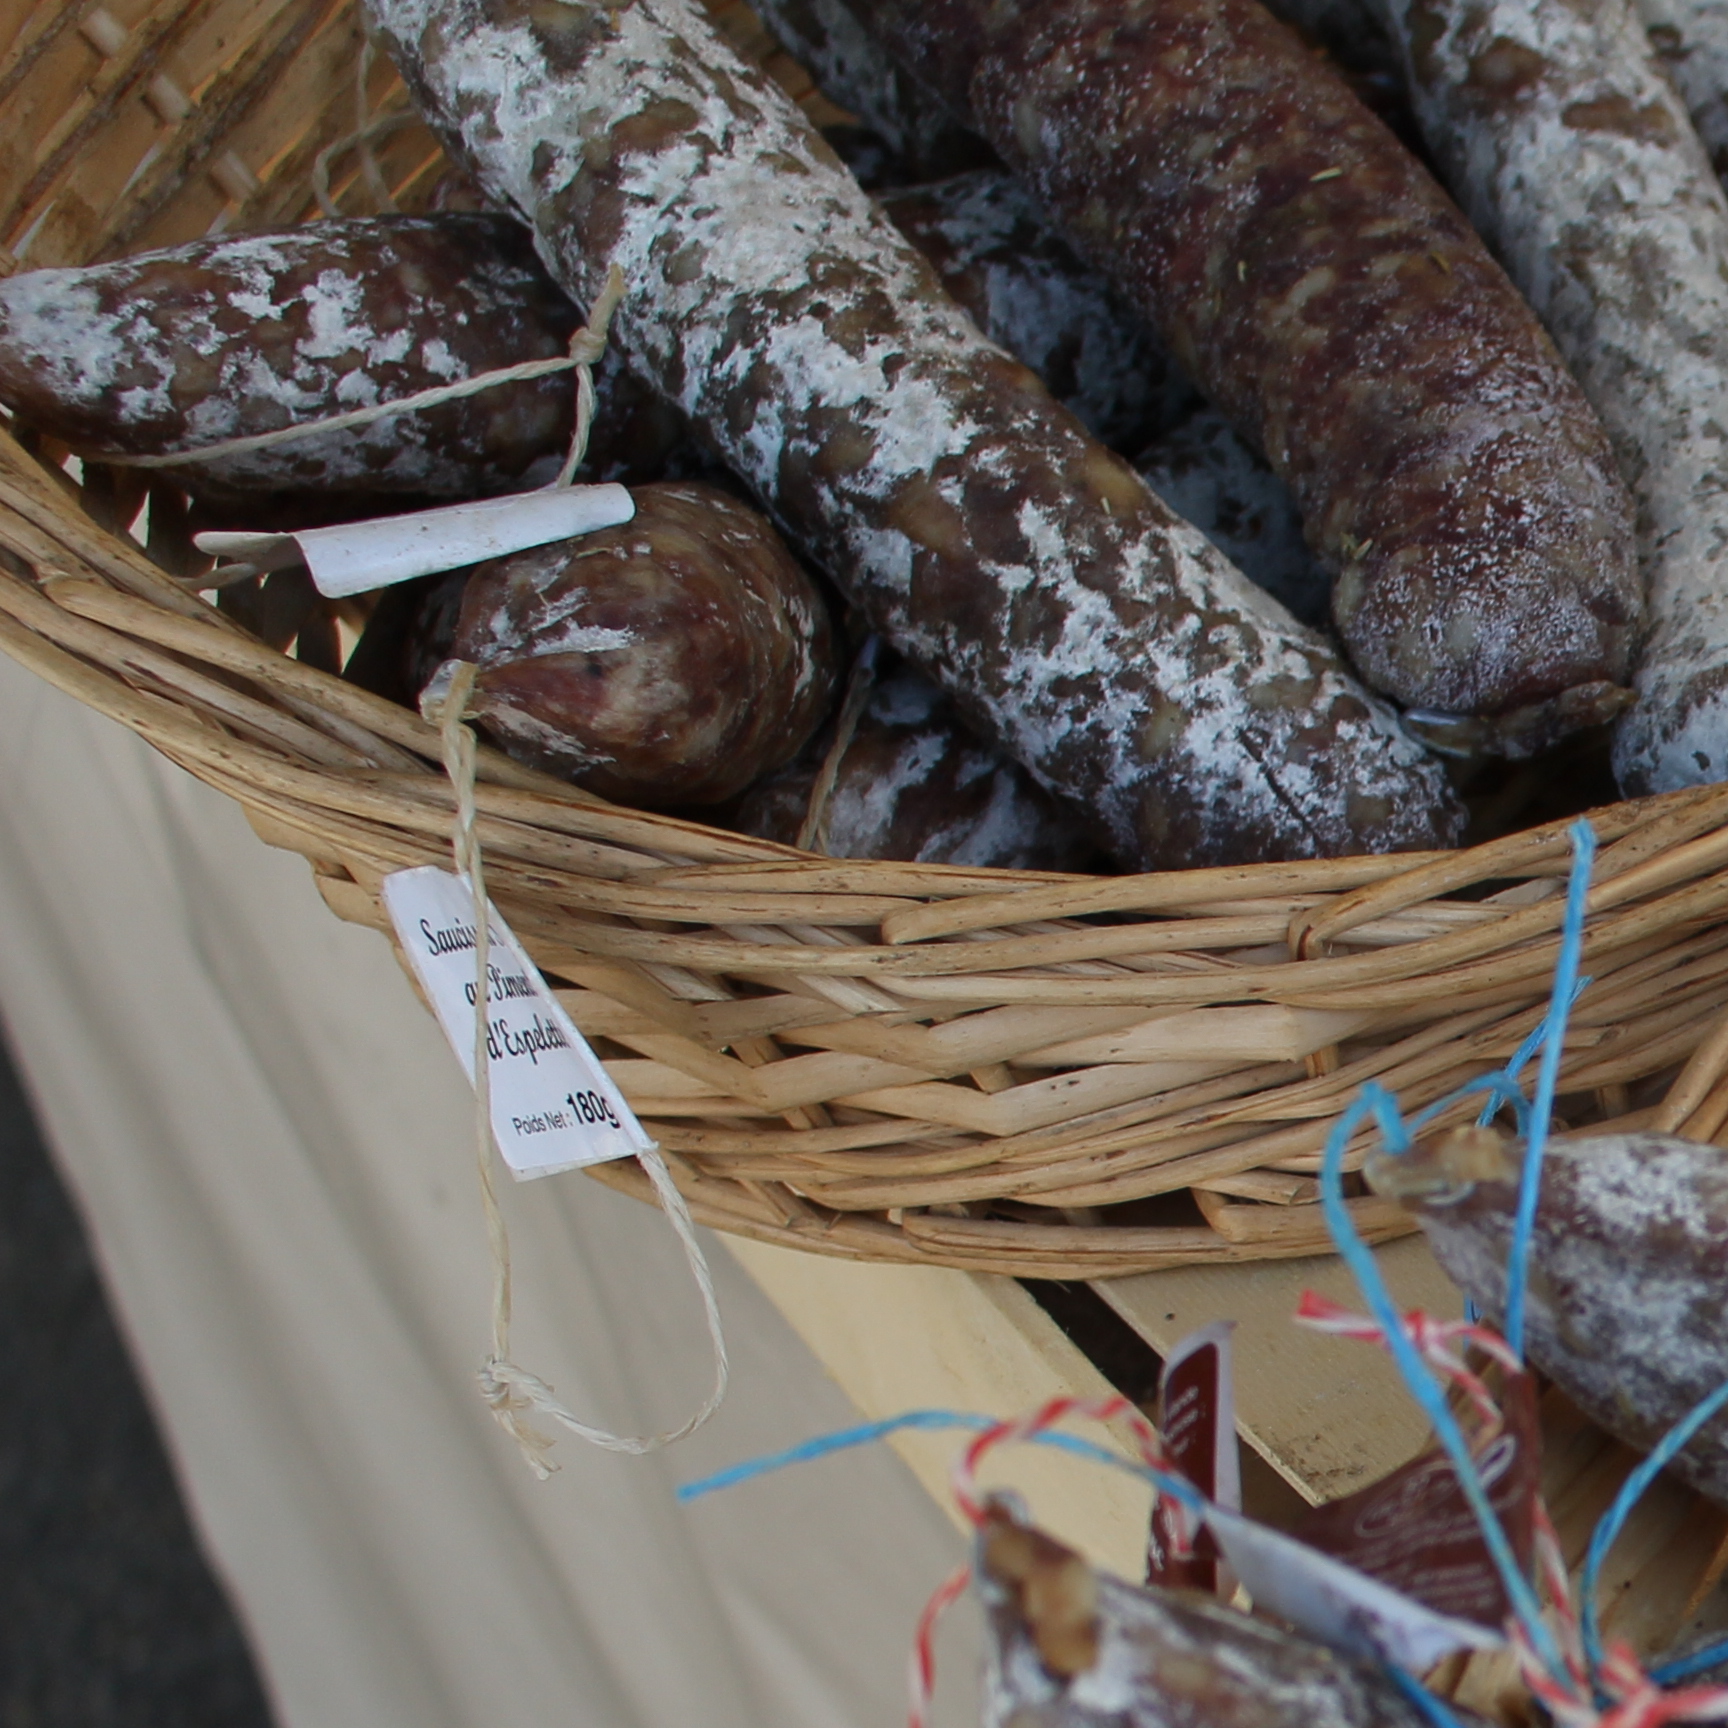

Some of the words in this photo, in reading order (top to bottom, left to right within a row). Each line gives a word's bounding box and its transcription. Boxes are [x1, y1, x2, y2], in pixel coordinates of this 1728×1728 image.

[512, 1113, 547, 1137] Poids
[547, 1110, 569, 1131] Net
[566, 1089, 621, 1129] 180g
